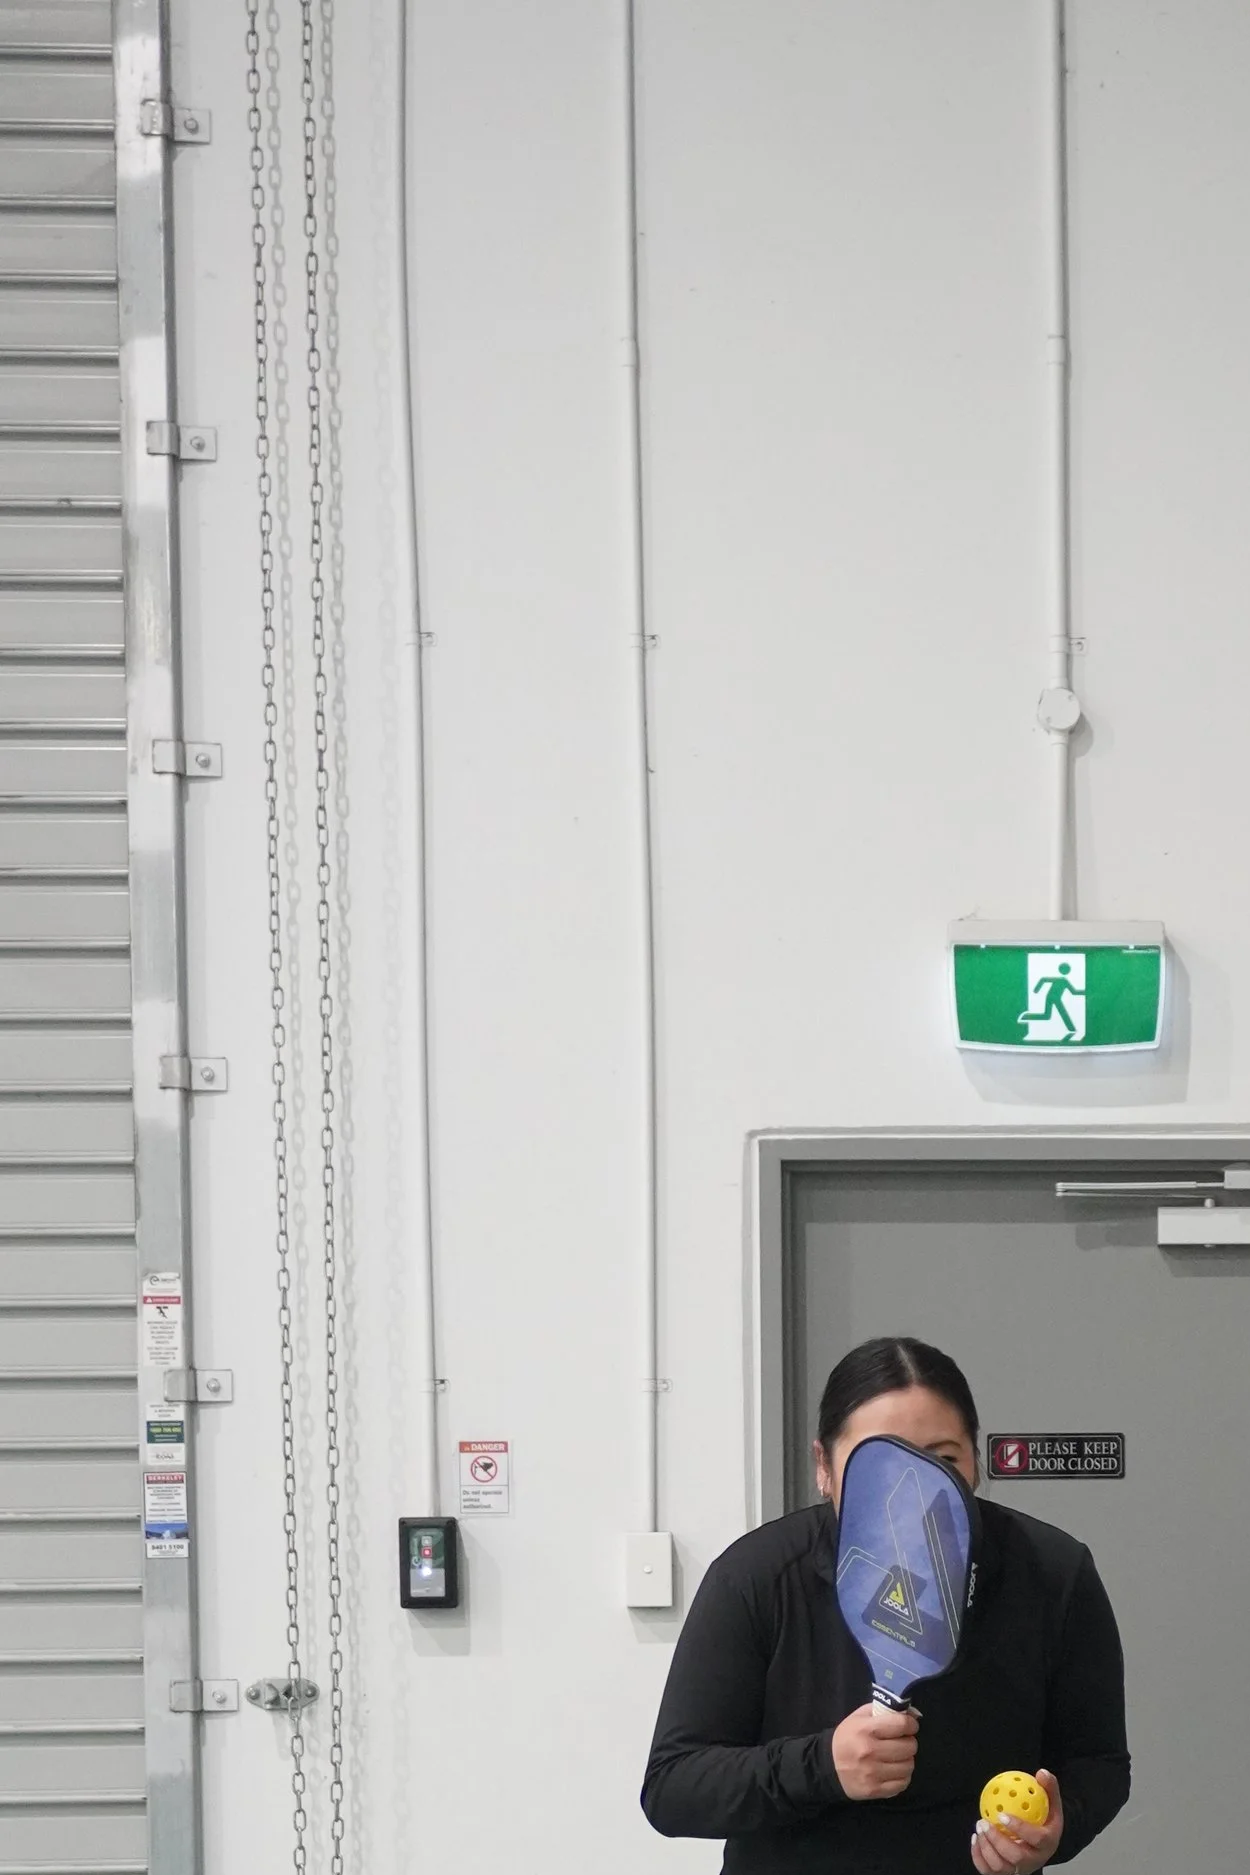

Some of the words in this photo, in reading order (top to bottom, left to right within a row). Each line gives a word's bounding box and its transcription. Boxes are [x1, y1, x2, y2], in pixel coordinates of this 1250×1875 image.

[471, 1443, 506, 1451] DANGER
[1028, 1442, 1077, 1455] PLEASE
[1084, 1442, 1118, 1455] KEEP
[1028, 1458, 1066, 1471] DOOR
[1068, 1458, 1118, 1471] CLOSED
[883, 1596, 909, 1616] JOOLA
[871, 1619, 916, 1648] ESSENTIALS
